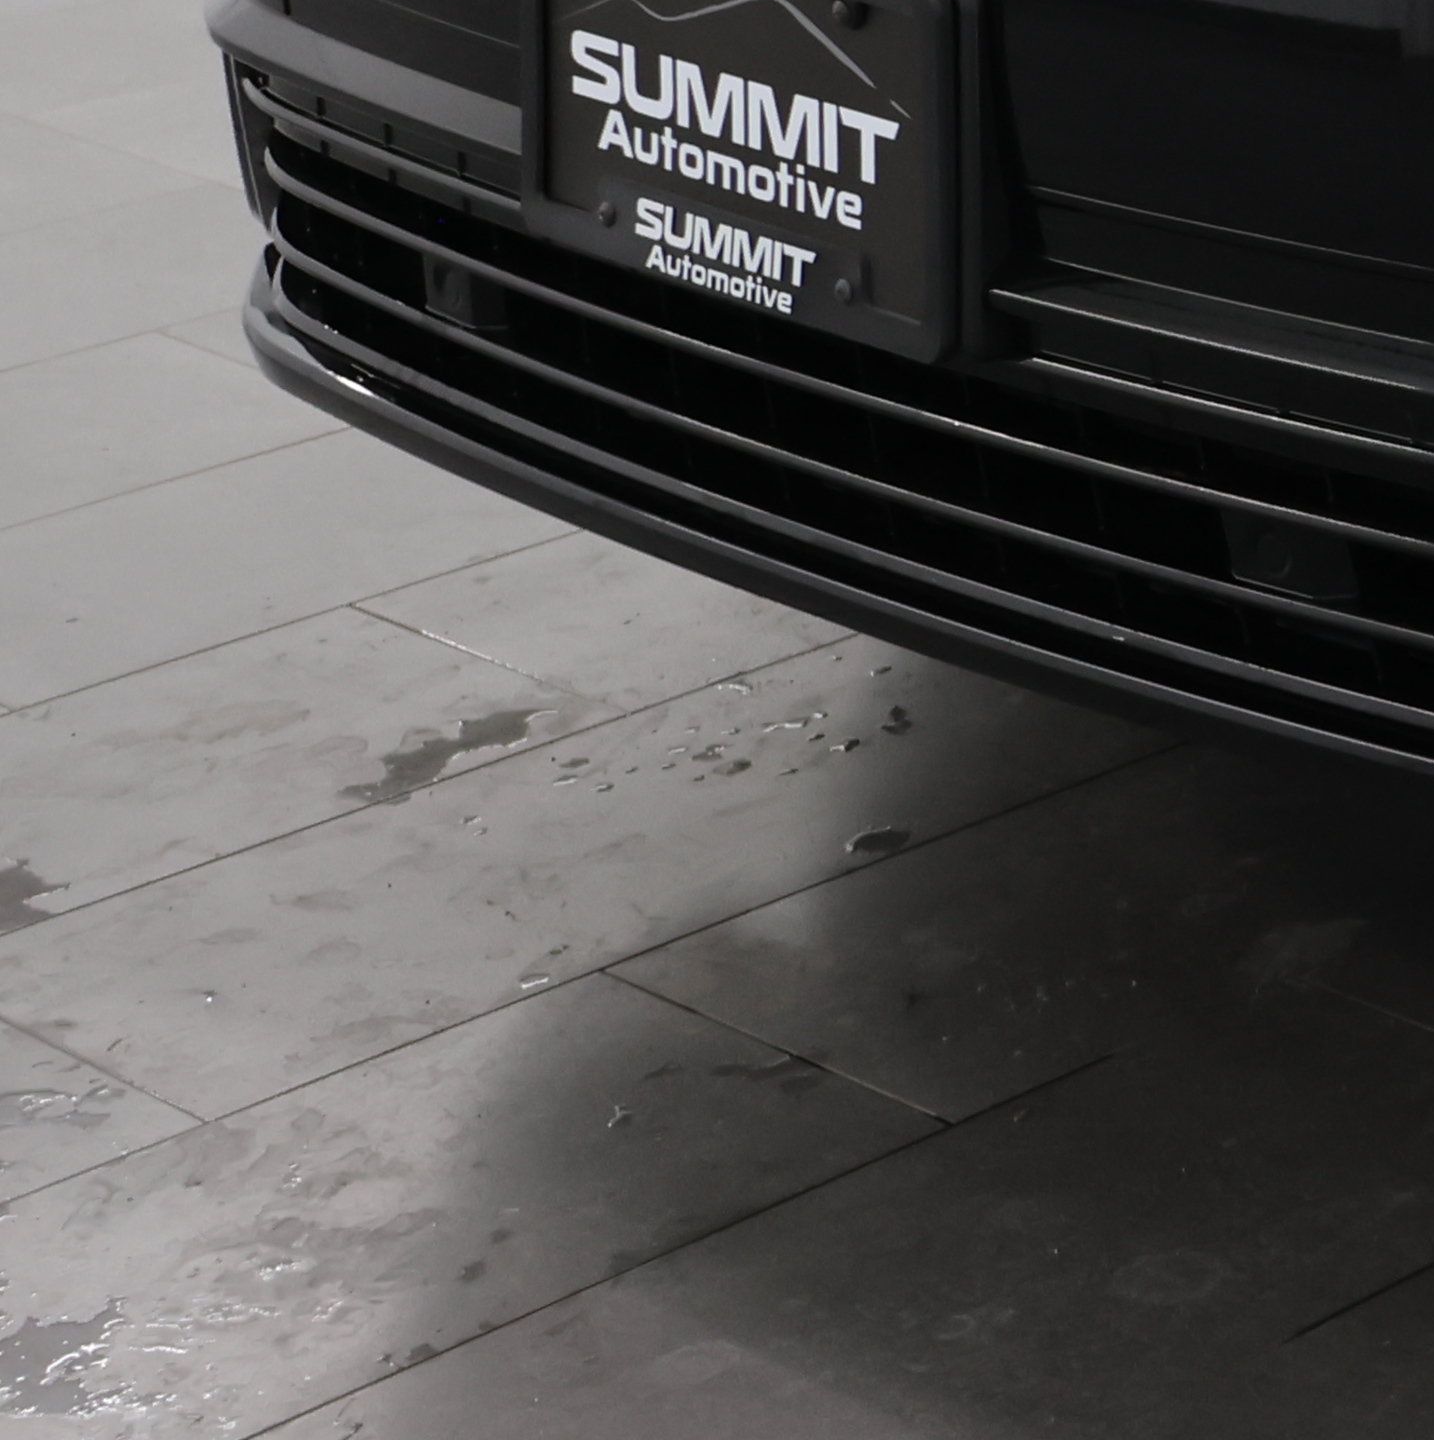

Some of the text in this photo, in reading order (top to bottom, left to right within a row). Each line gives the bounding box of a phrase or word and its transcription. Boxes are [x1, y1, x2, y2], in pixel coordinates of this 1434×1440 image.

[570, 29, 900, 185] SUMMIT
[597, 109, 863, 231] Automotive
[634, 197, 817, 288] SUMMIT
[645, 250, 794, 315] Automotive
